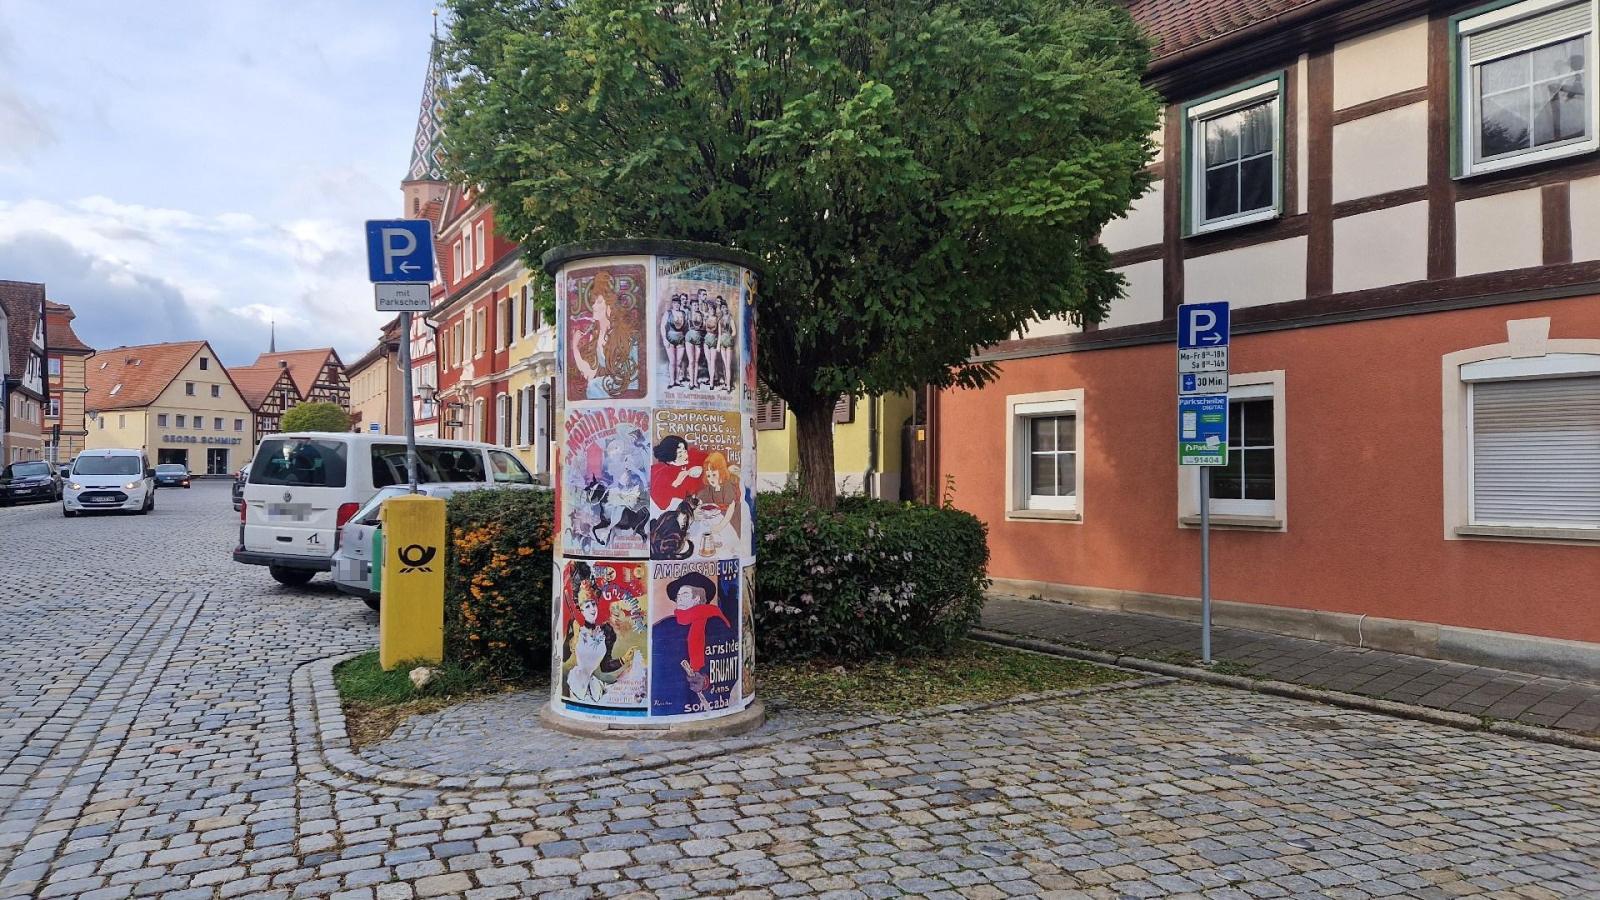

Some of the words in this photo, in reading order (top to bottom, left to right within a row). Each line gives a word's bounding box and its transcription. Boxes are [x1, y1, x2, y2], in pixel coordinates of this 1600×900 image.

[381, 228, 417, 274] P
[1189, 310, 1217, 345] P
[1180, 352, 1200, 360] Mo-Fr
[1192, 361, 1200, 369] Sa
[1197, 377, 1207, 387] 30
[1208, 377, 1225, 386] Min.
[655, 411, 726, 423] COMPAGNIE
[566, 410, 607, 456] MOULIN
[606, 407, 649, 433] ROUGE
[163, 434, 197, 444] GEORG
[200, 436, 242, 445] SCHMIDT
[704, 639, 739, 656] aristide
[709, 656, 738, 684] BRUANT
[710, 684, 730, 695] dans
[684, 703, 705, 713] son
